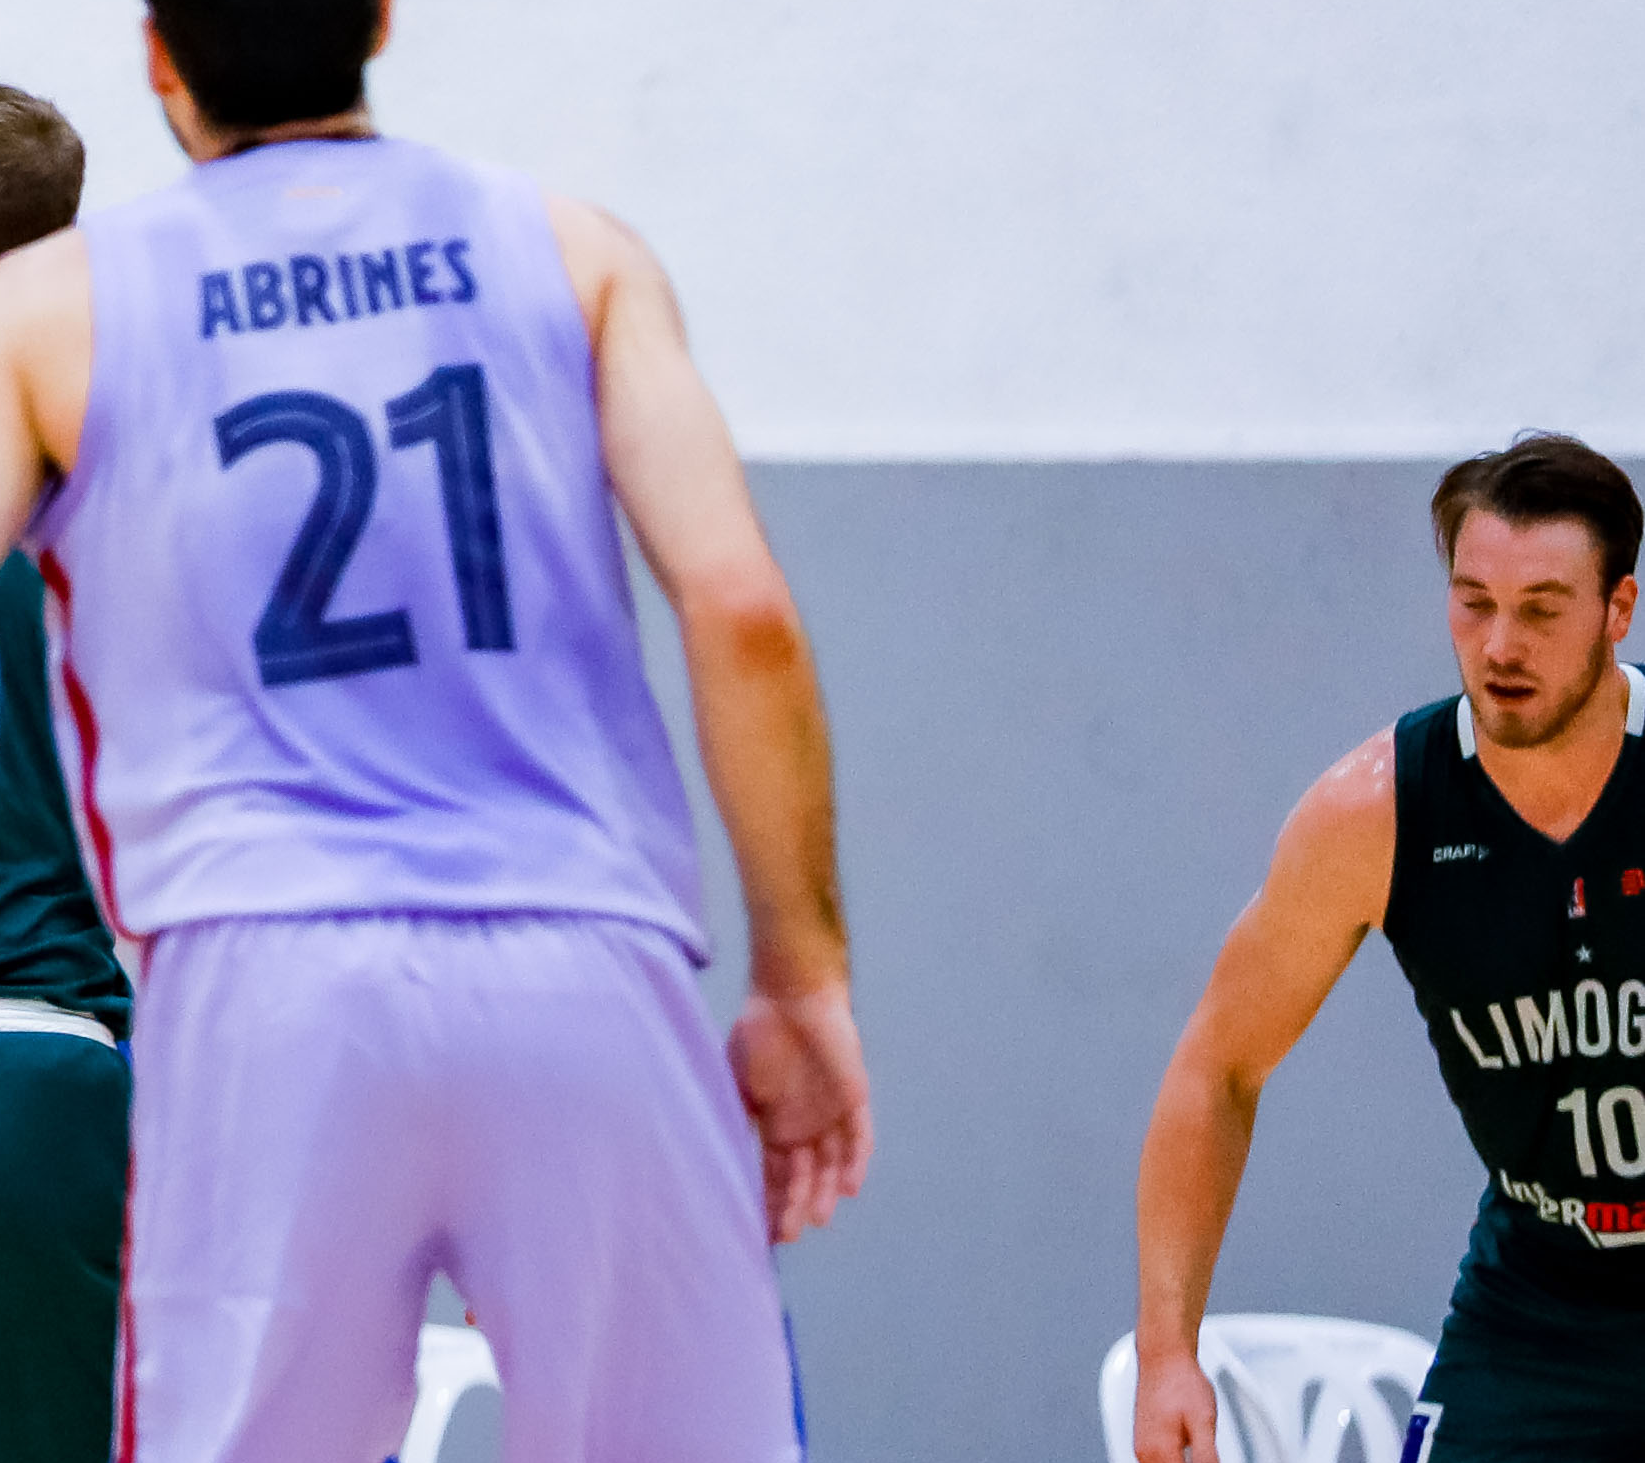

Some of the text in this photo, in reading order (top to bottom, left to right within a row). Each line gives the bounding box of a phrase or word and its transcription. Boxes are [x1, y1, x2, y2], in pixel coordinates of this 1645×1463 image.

[198, 238, 479, 339] ABRINES
[213, 363, 517, 687] 21
[1556, 1084, 1645, 1178] 10
